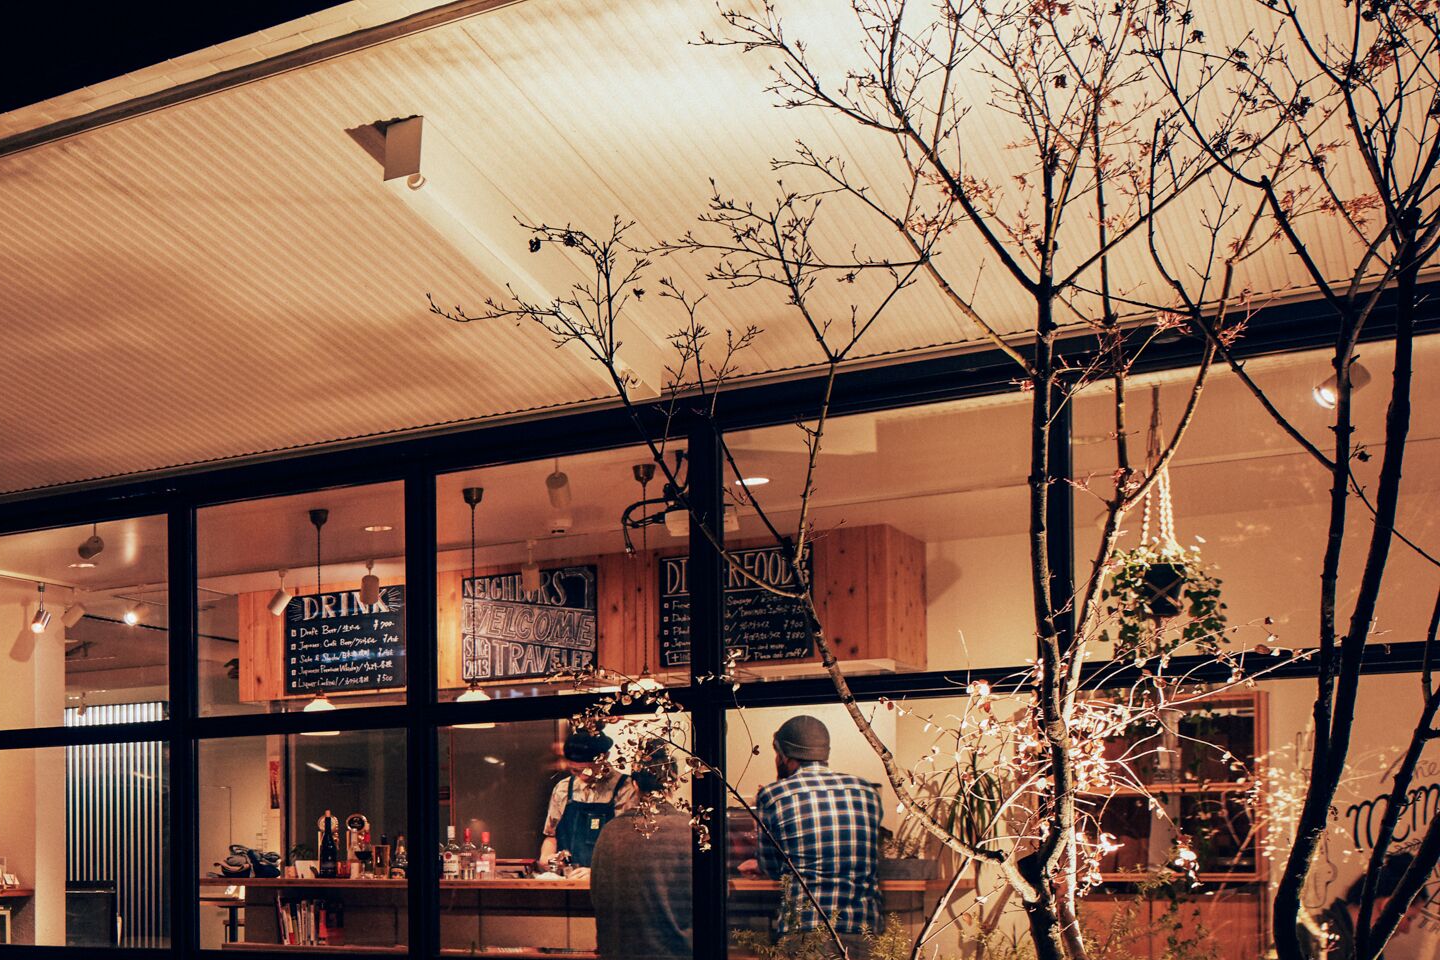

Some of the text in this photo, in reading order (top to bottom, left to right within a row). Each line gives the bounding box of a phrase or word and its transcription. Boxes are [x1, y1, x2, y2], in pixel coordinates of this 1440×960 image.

[302, 588, 390, 621] DRINK
[464, 602, 596, 649] WELCOME
[465, 639, 489, 657] SNCE
